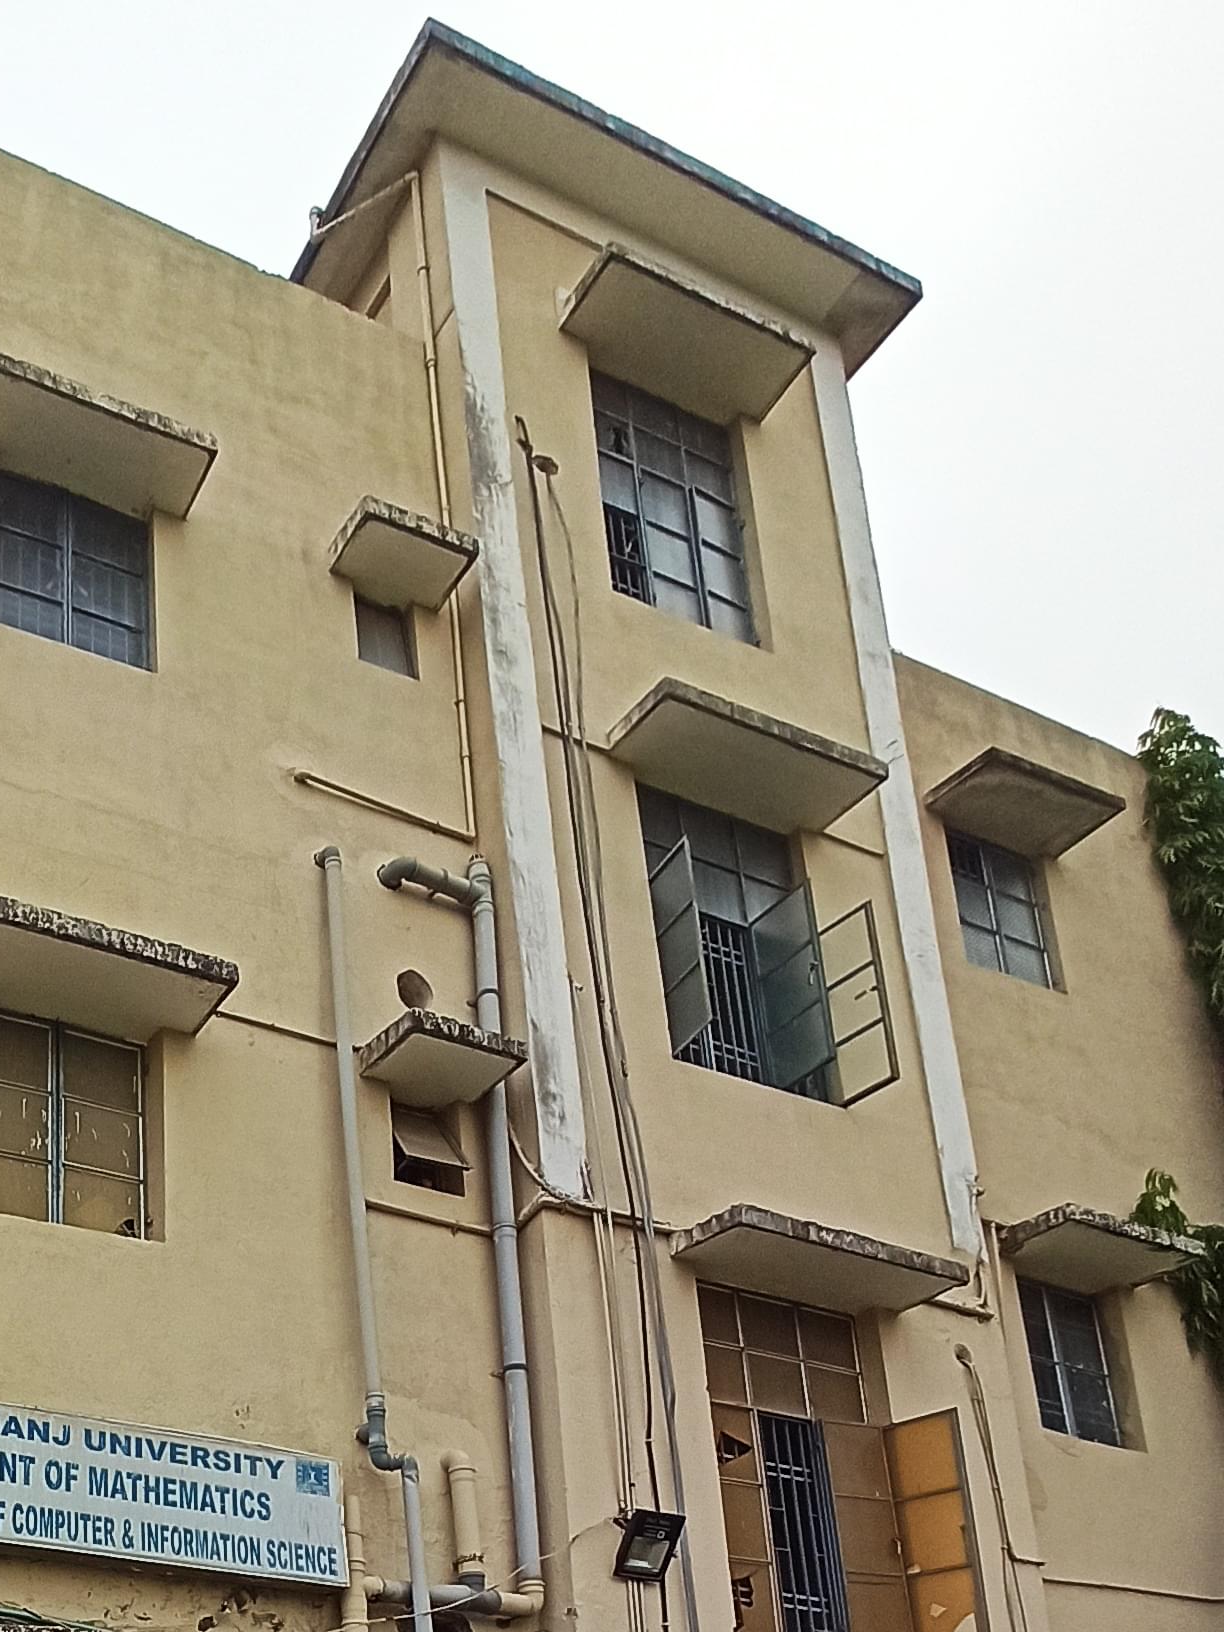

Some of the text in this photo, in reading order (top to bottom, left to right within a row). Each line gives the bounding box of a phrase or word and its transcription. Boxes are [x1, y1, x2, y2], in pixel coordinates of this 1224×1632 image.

[84, 1429, 286, 1480] UNIVERSITY
[44, 1459, 79, 1493] OF
[88, 1467, 272, 1521] MATHEMATICS
[12, 1505, 115, 1549] COMPUTER
[122, 1523, 135, 1549] &
[141, 1521, 262, 1568] INFORMATION
[266, 1544, 339, 1577] SCIENCE
